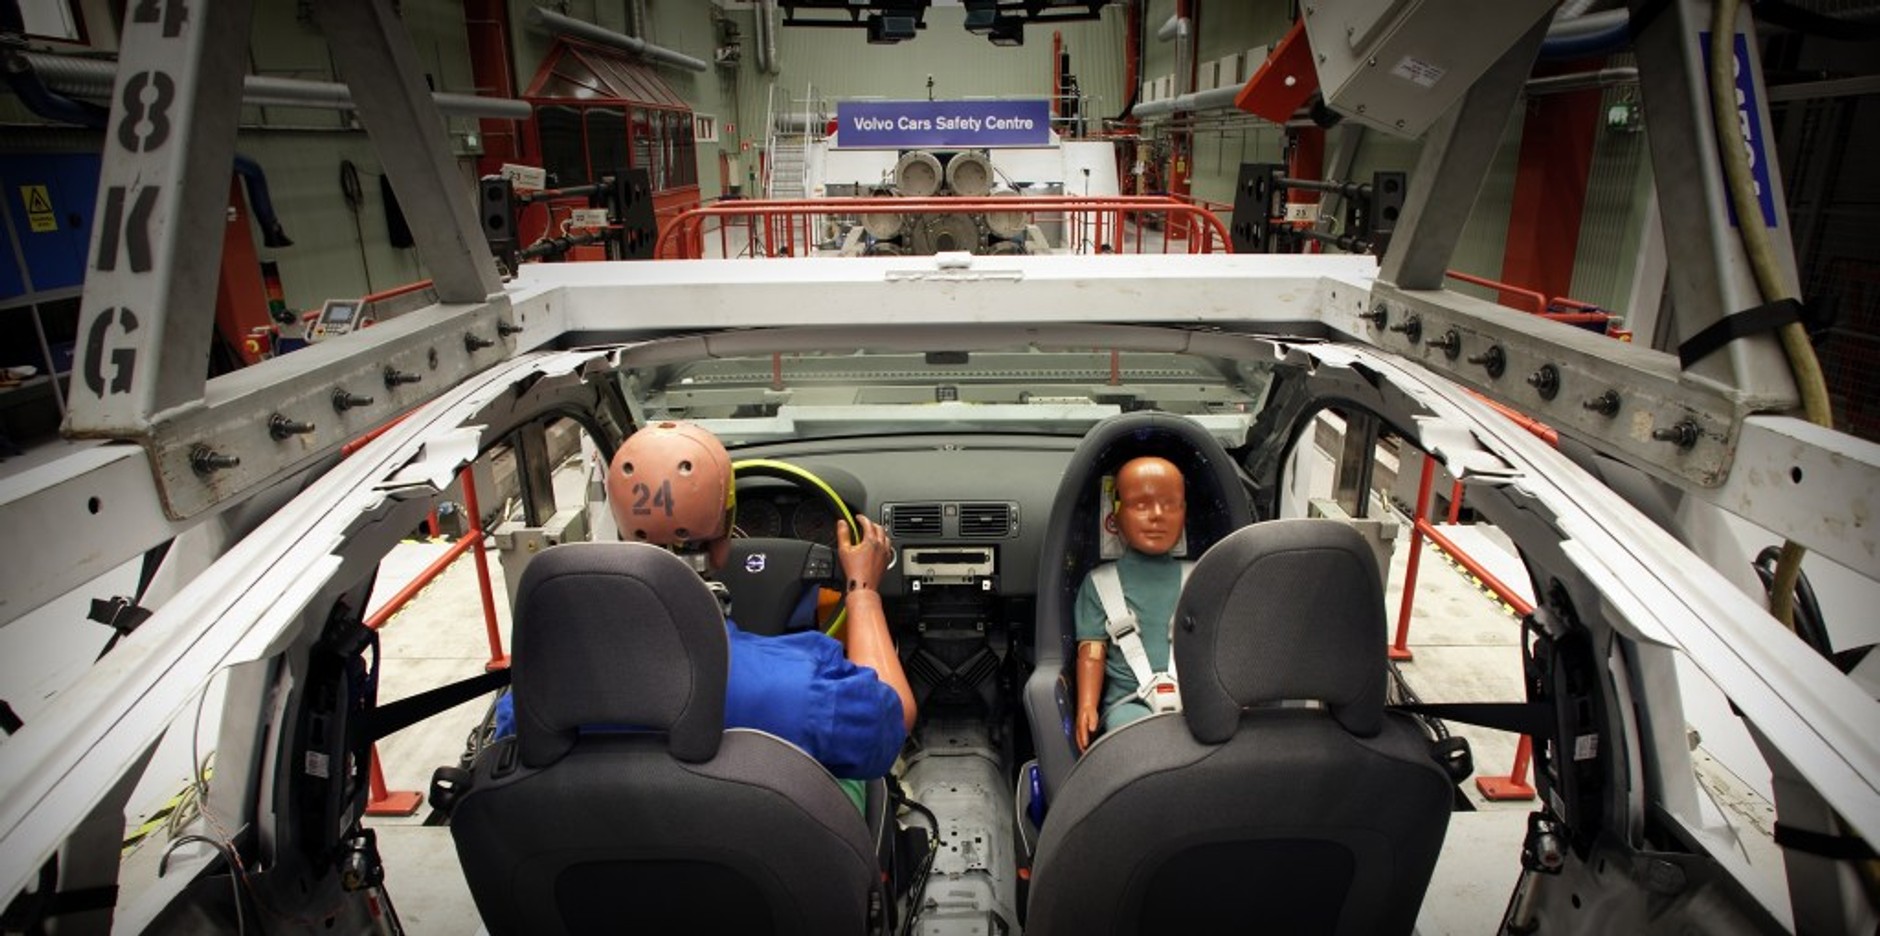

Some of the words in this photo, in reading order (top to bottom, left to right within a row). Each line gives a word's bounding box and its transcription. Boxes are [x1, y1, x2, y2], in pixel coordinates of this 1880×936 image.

[854, 116, 893, 131] Volvo
[897, 116, 931, 130] Cars
[935, 116, 982, 132] Safety
[985, 115, 1034, 130] Centre
[632, 479, 675, 517] 24
